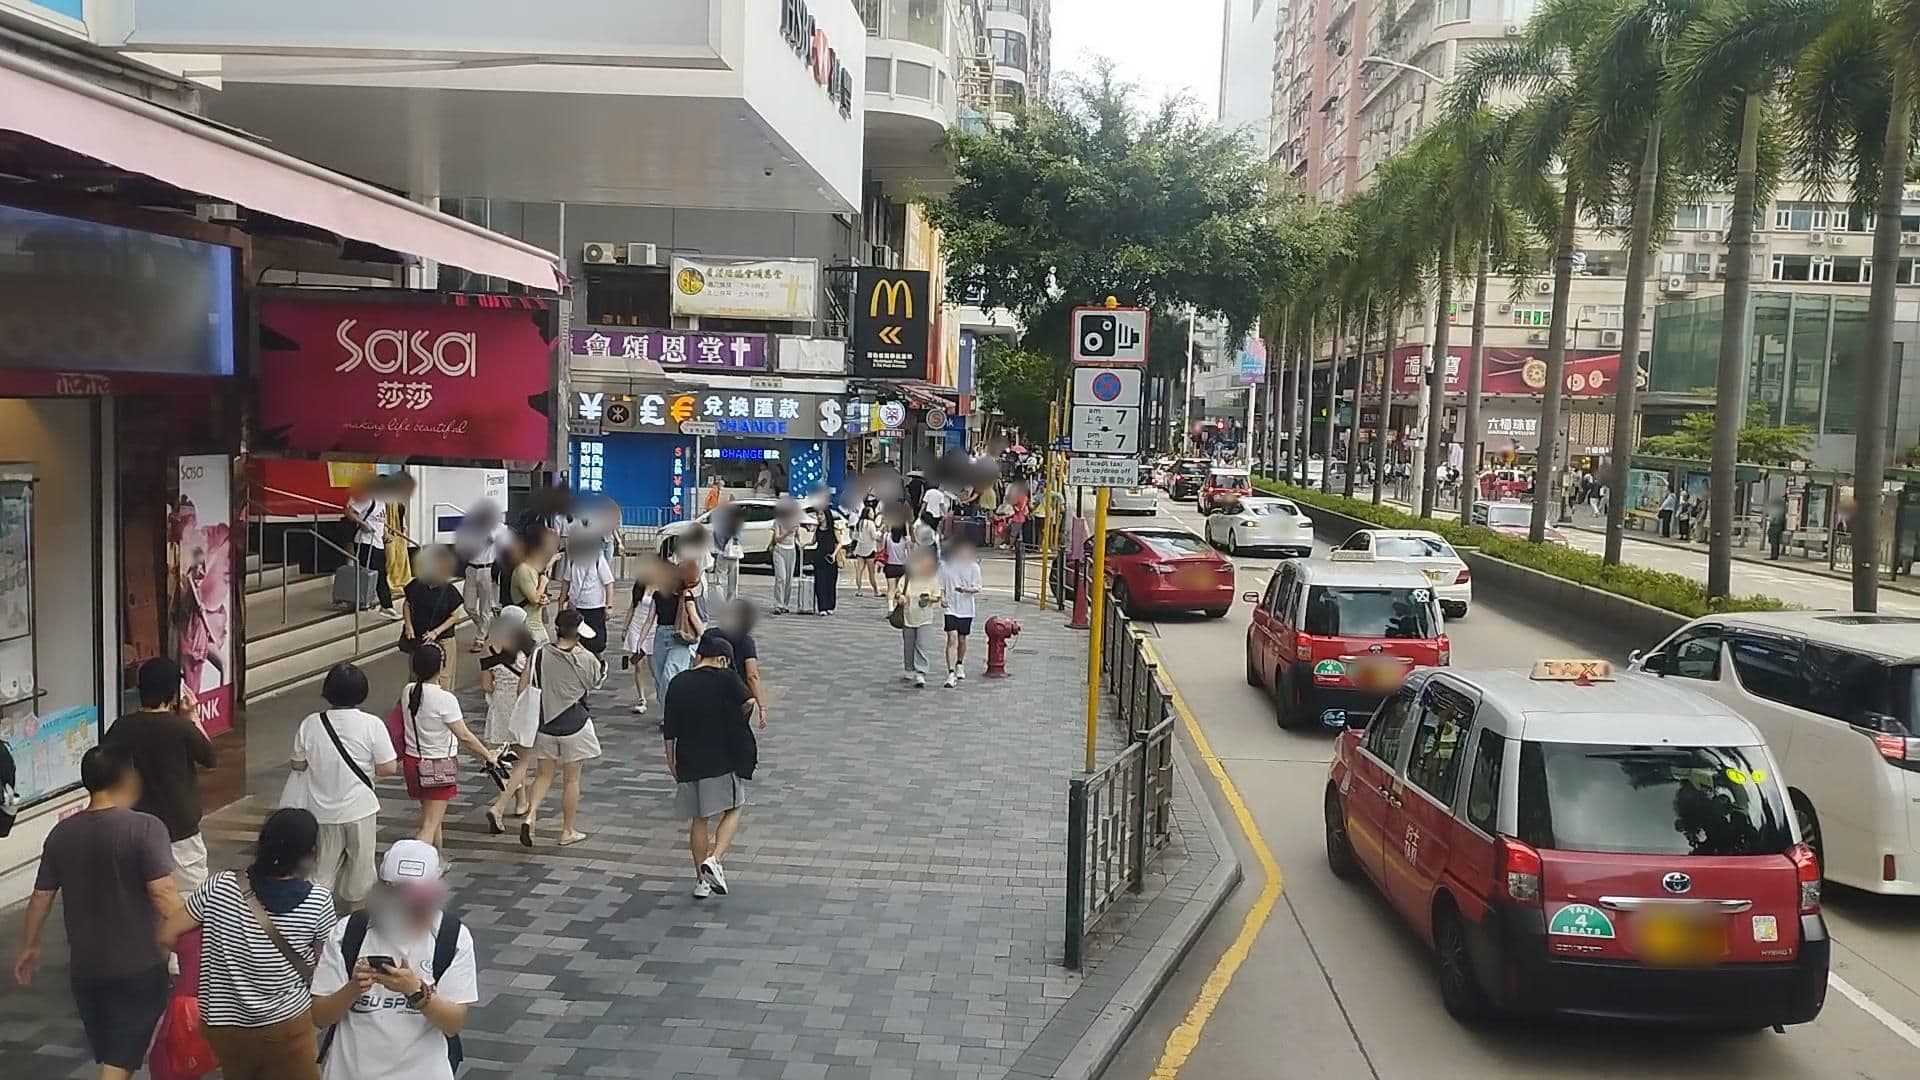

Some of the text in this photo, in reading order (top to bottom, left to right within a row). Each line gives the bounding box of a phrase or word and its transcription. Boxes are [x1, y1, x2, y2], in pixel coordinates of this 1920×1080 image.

[335, 318, 477, 377] Sasa
[568, 332, 726, 364] 會頌恩堂
[377, 380, 433, 410] 莎莎
[1084, 415, 1104, 425] 上午
[1116, 410, 1127, 425] 7
[387, 417, 410, 437] life
[716, 417, 788, 435] CHANGE
[1084, 440, 1103, 449] 下午
[1115, 434, 1126, 449] 7
[721, 449, 764, 459] CHANGE
[1567, 907, 1594, 915] TAXI
[1574, 914, 1588, 927] 4
[1562, 925, 1601, 935] SEATS
